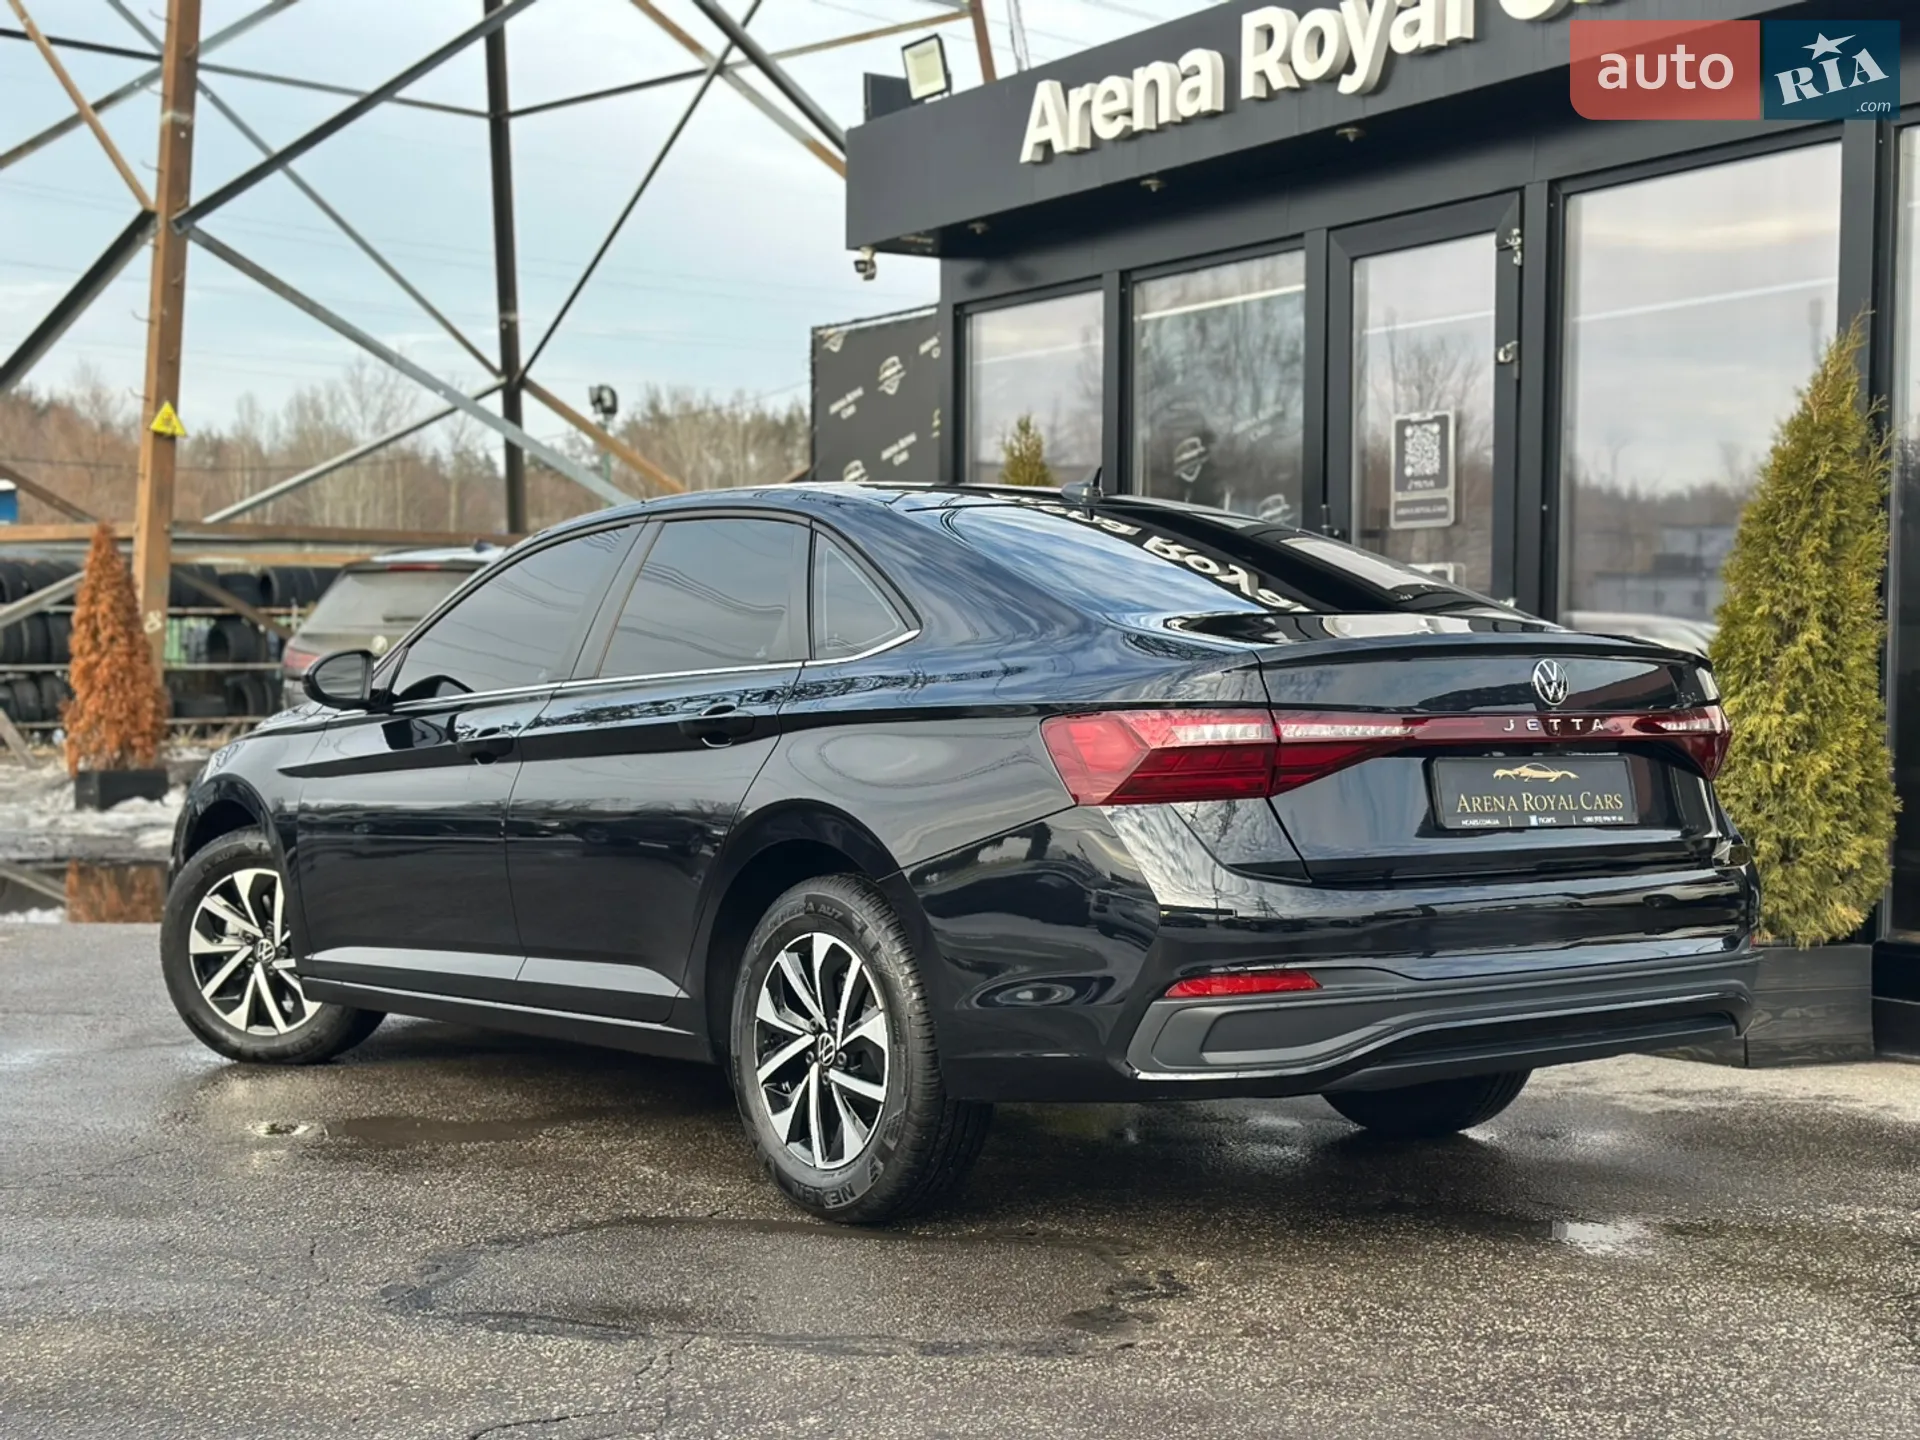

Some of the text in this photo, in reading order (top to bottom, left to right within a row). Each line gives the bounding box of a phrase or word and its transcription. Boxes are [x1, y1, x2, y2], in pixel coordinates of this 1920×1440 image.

[1020, 50, 1225, 163] Arena
[1503, 718, 1605, 732] JETTA
[1456, 791, 1624, 813] ARENA ROYAL CARS
